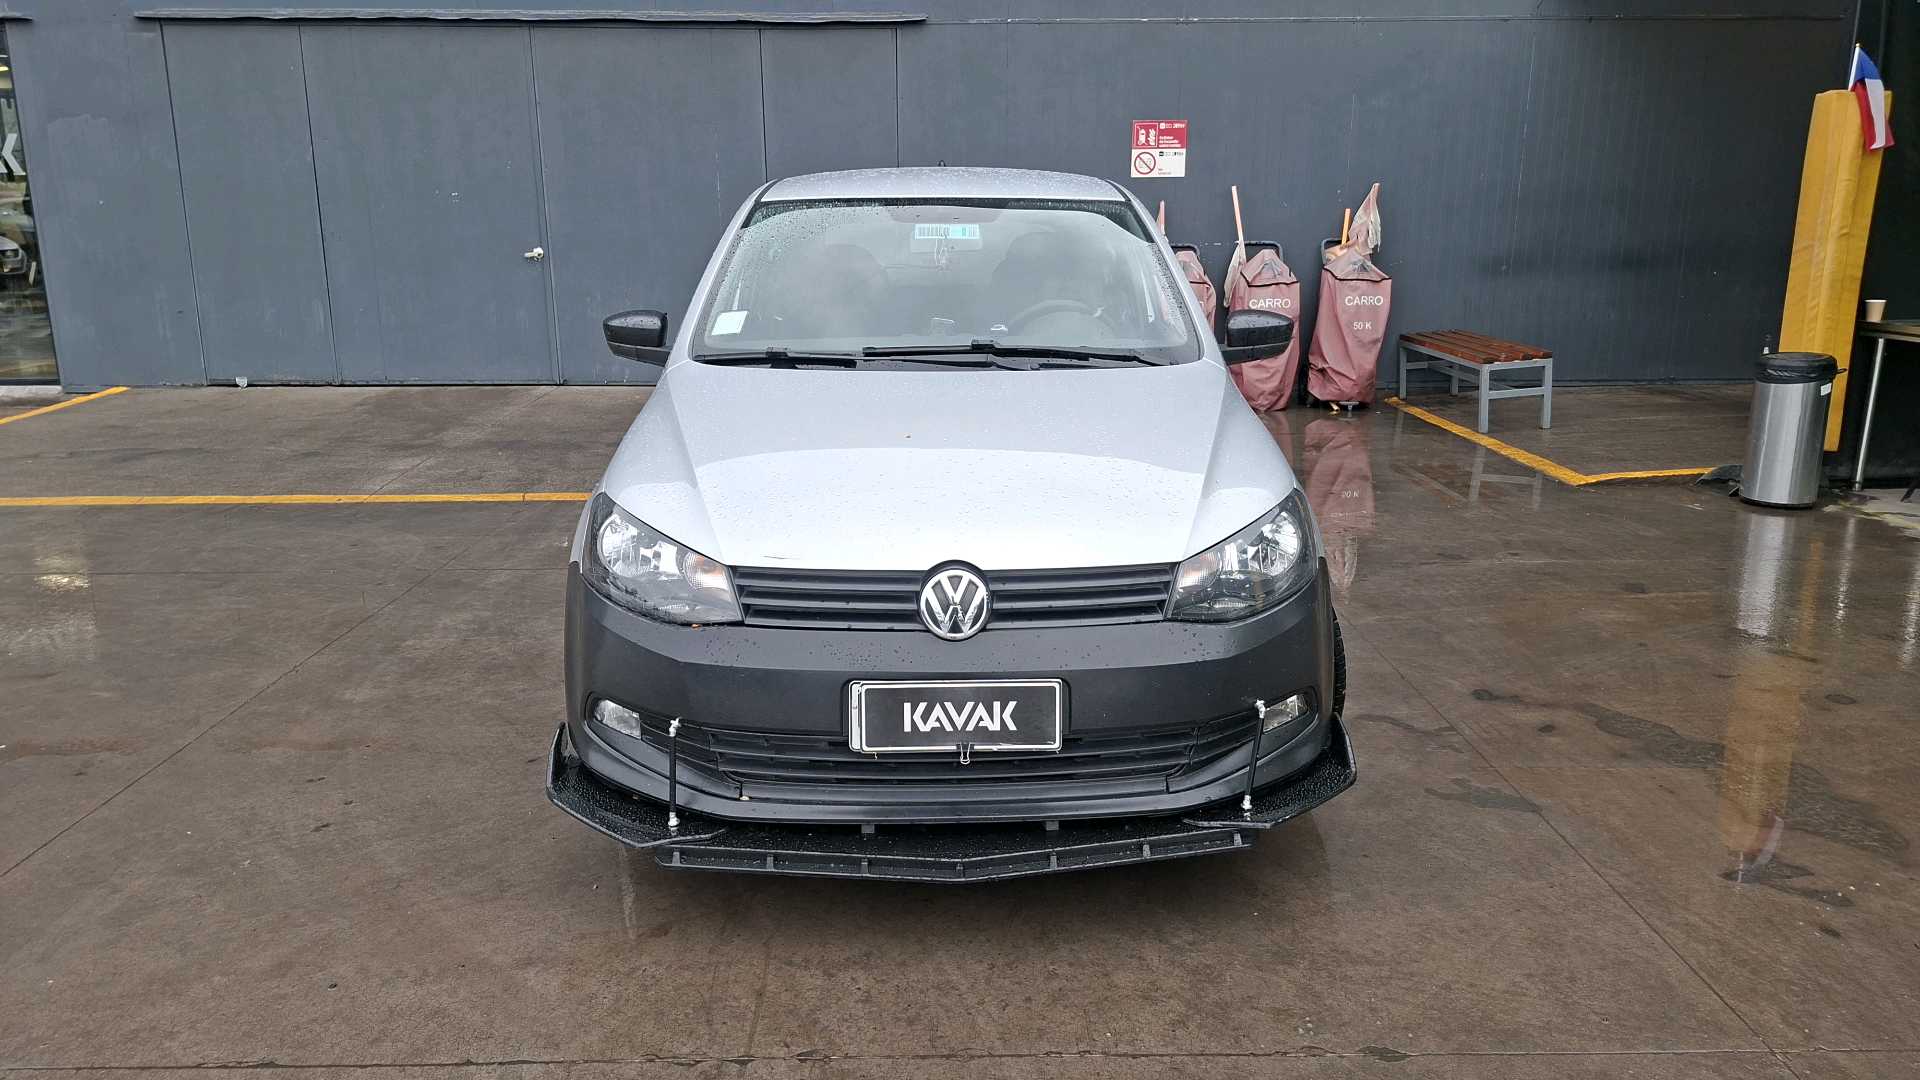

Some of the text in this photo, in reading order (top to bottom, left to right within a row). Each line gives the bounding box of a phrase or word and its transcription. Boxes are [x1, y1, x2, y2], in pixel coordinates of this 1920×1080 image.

[1249, 298, 1291, 309] CARRO
[1345, 296, 1384, 307] CARRO
[1353, 321, 1373, 331] 50 K
[903, 701, 1018, 732] KAVAK
